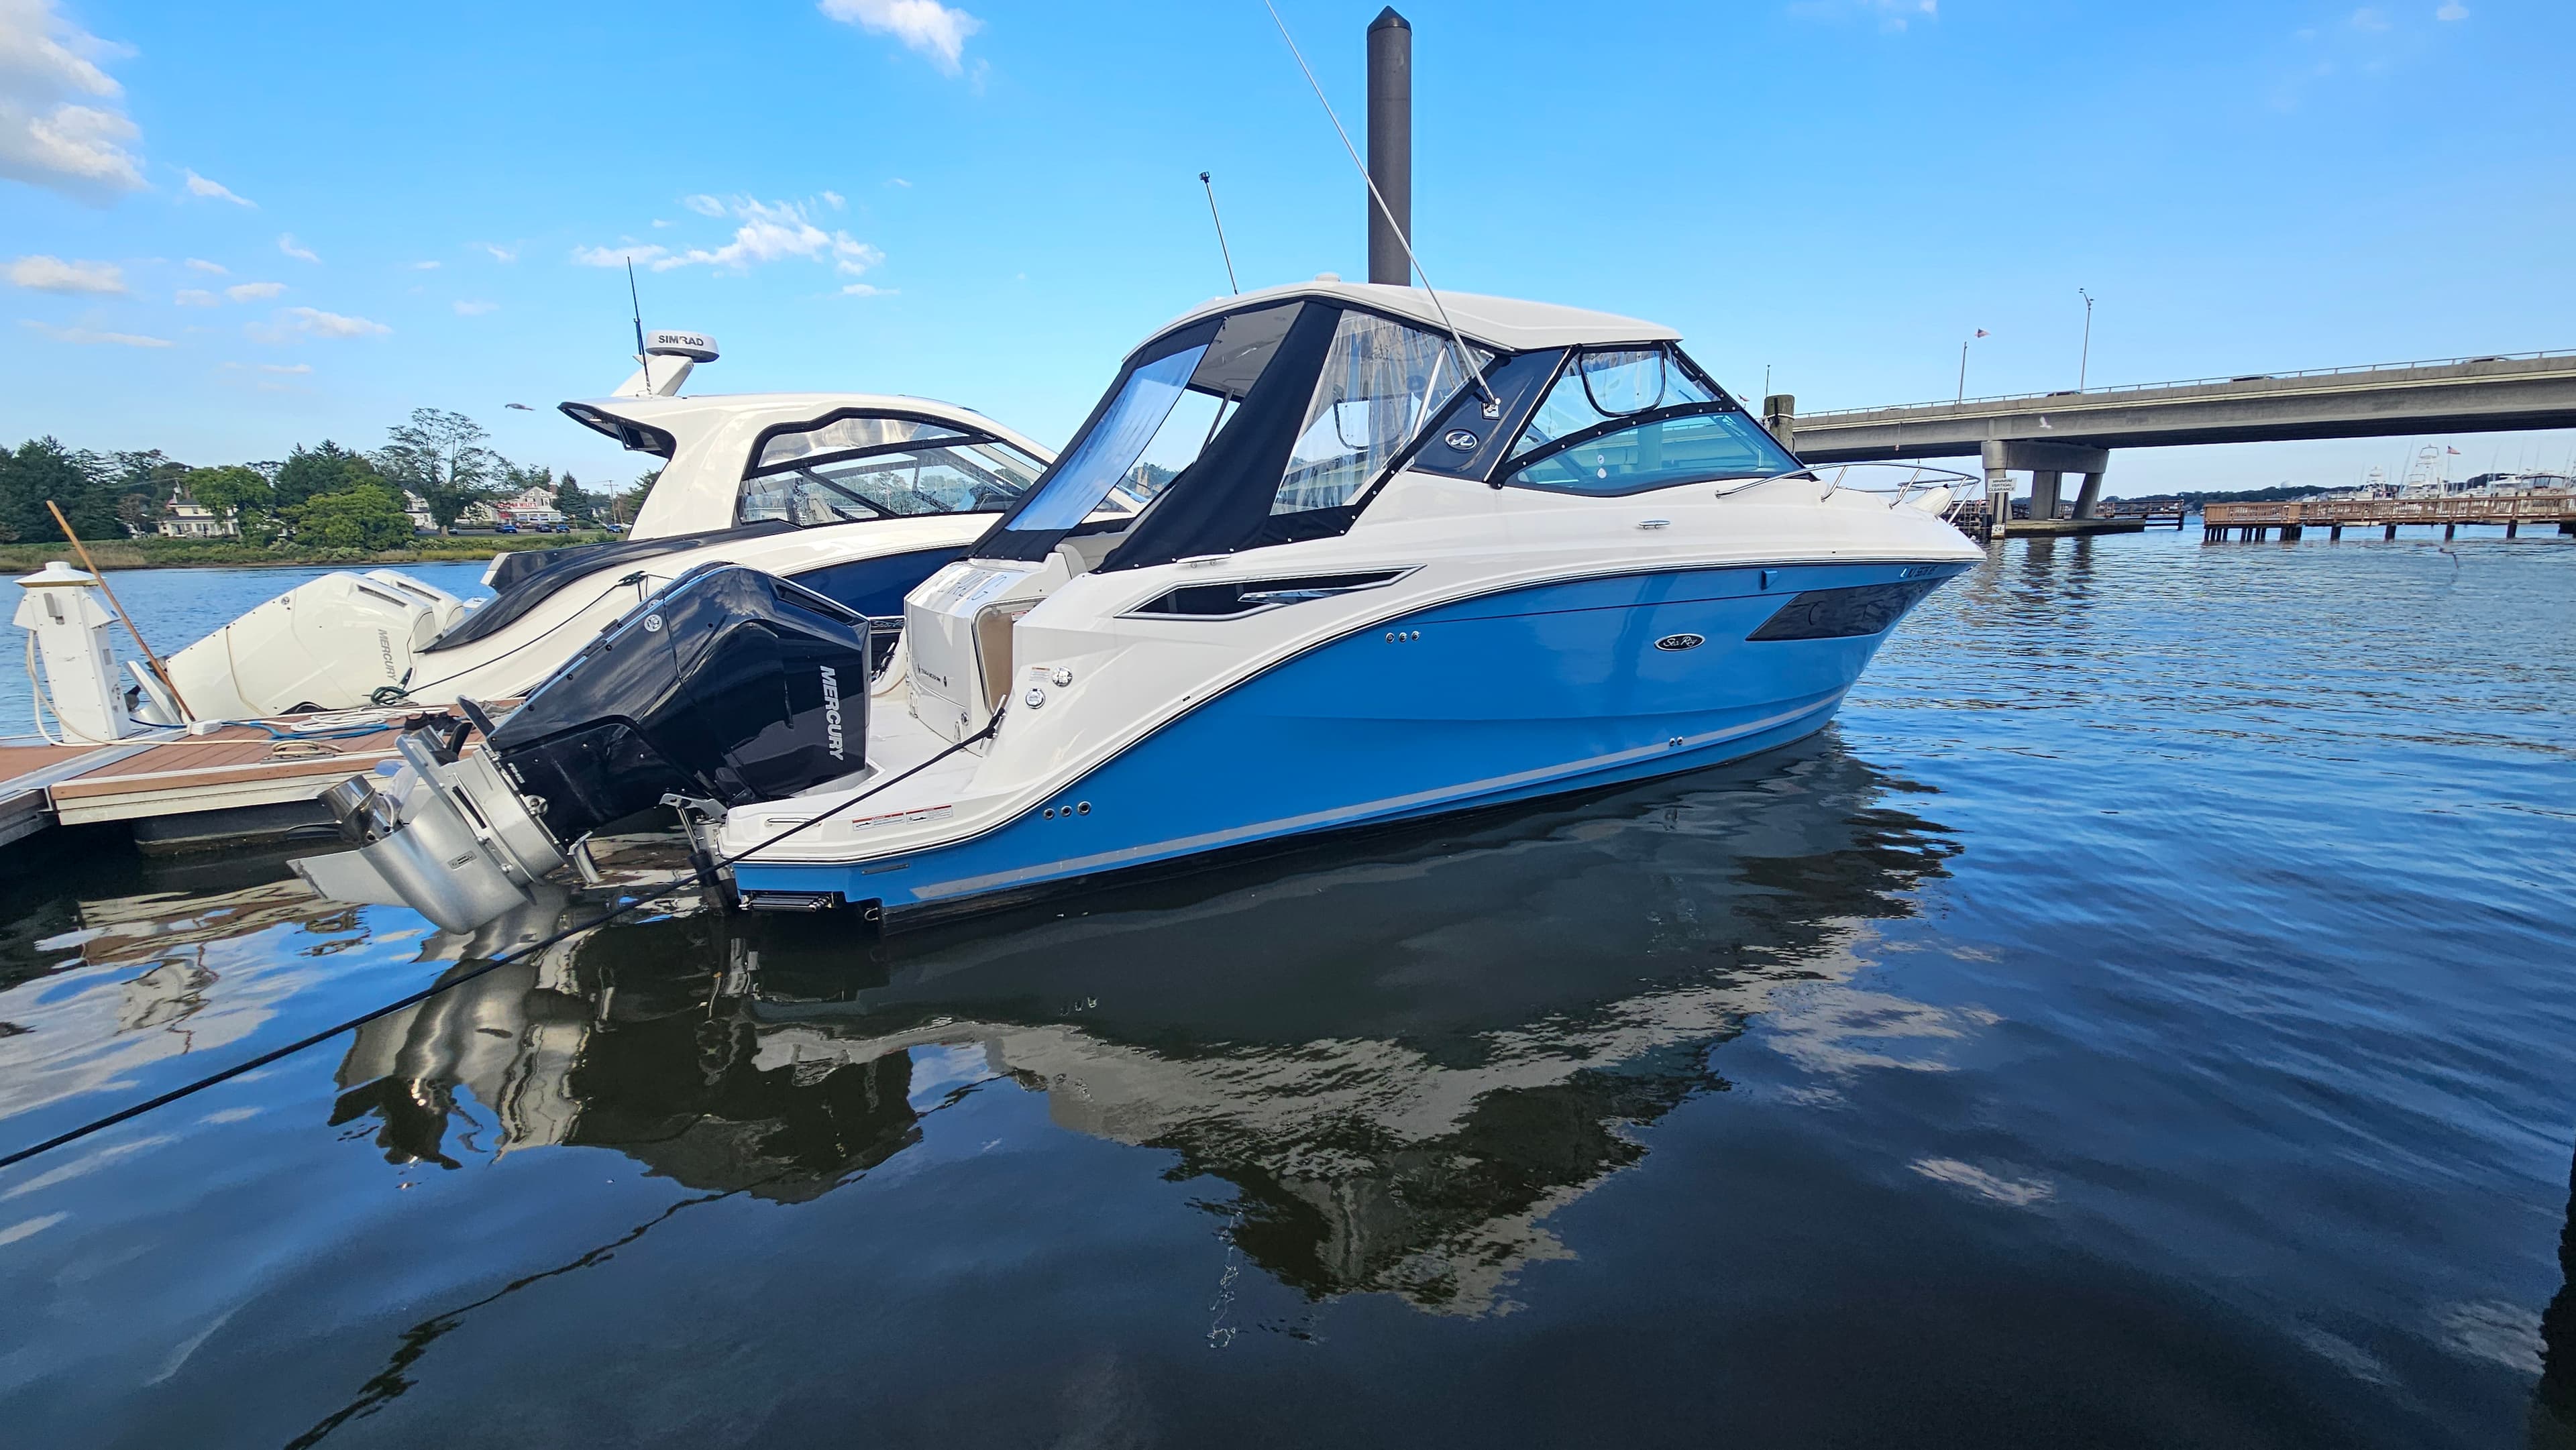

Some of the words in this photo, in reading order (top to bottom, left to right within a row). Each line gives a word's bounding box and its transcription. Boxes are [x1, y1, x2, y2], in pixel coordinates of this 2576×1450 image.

[658, 335, 704, 346] SIMRAD
[378, 628, 398, 681] MERCURY
[1663, 638, 1680, 647] Sea
[1680, 636, 1697, 647] Ray
[820, 665, 844, 761] MERCURY
